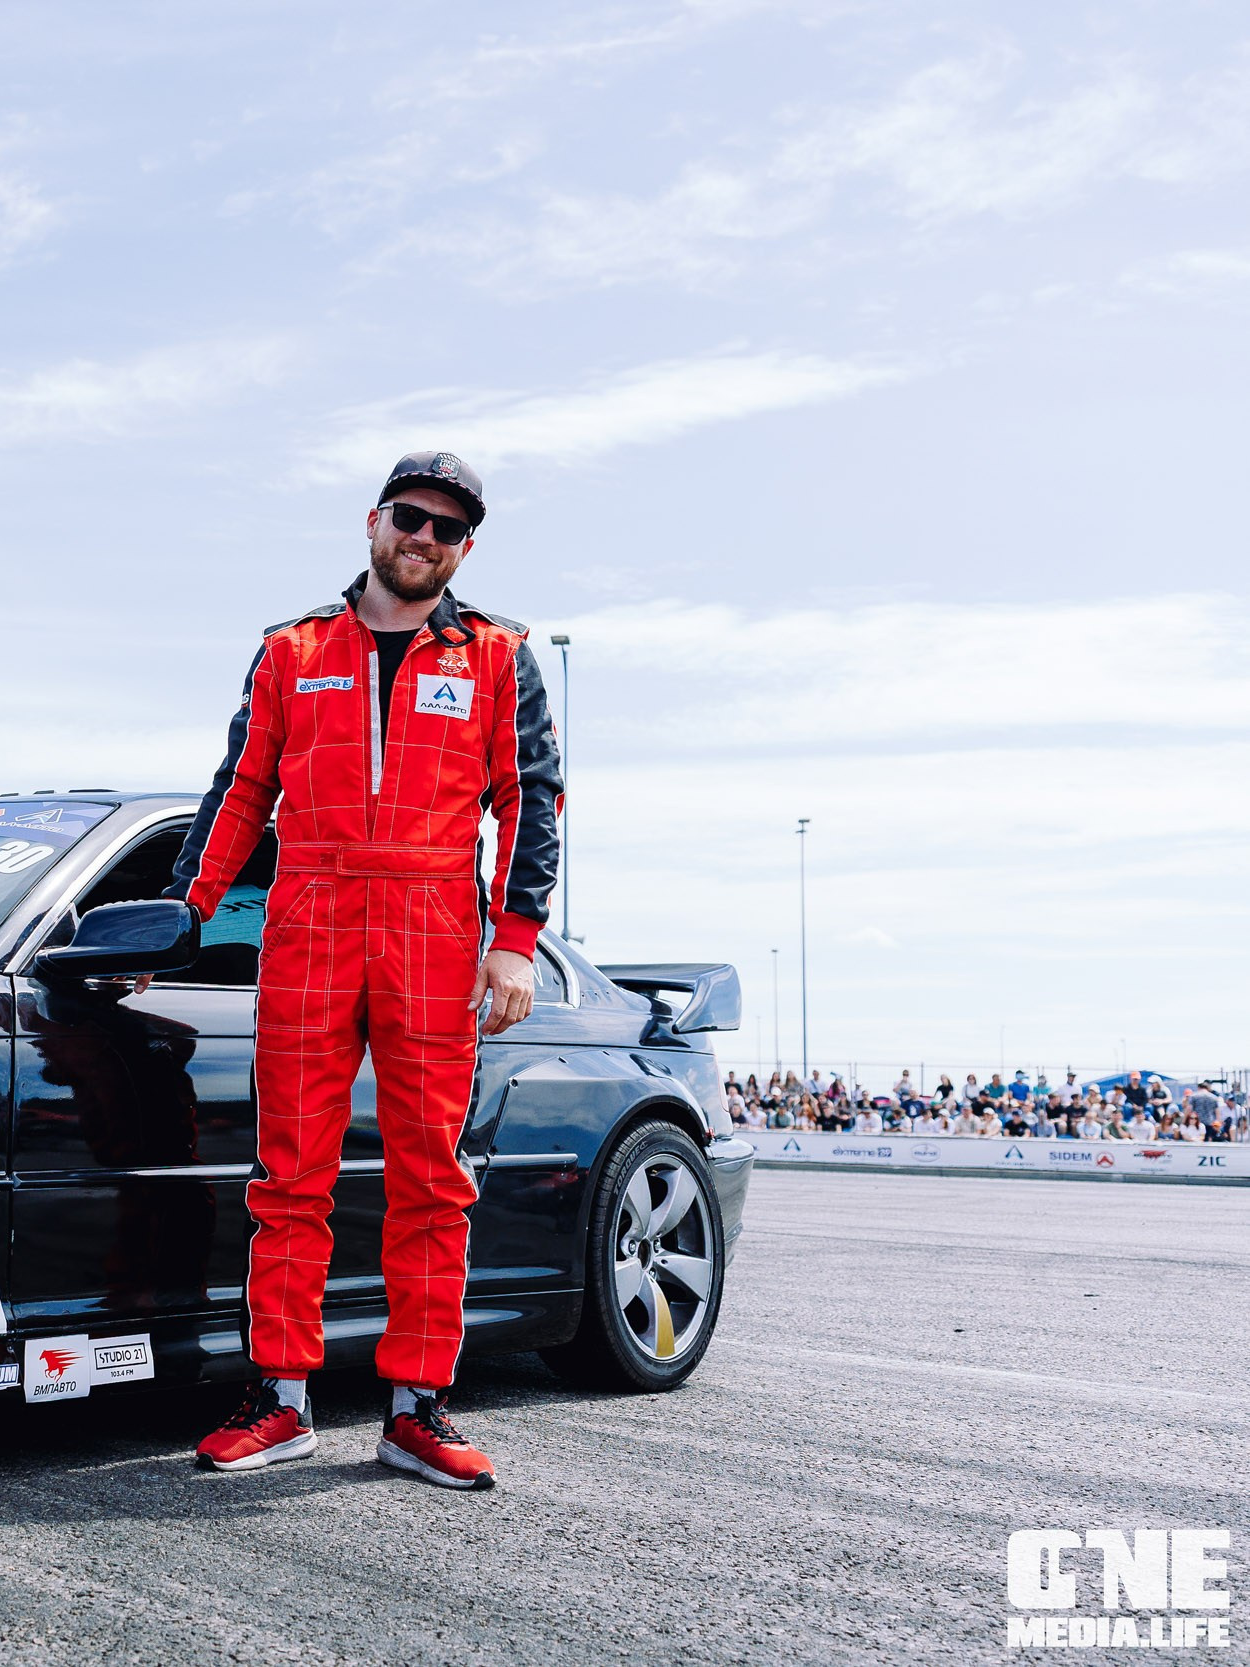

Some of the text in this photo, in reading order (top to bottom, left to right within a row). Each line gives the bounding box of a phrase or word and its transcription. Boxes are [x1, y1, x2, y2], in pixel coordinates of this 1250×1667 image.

[1049, 1151, 1093, 1162] SIDEM
[1197, 1155, 1228, 1167] ZIC
[99, 1348, 143, 1364] STUDIO 21
[110, 1370, 125, 1378] 103.4
[34, 1380, 77, 1396] ВМПАВТО
